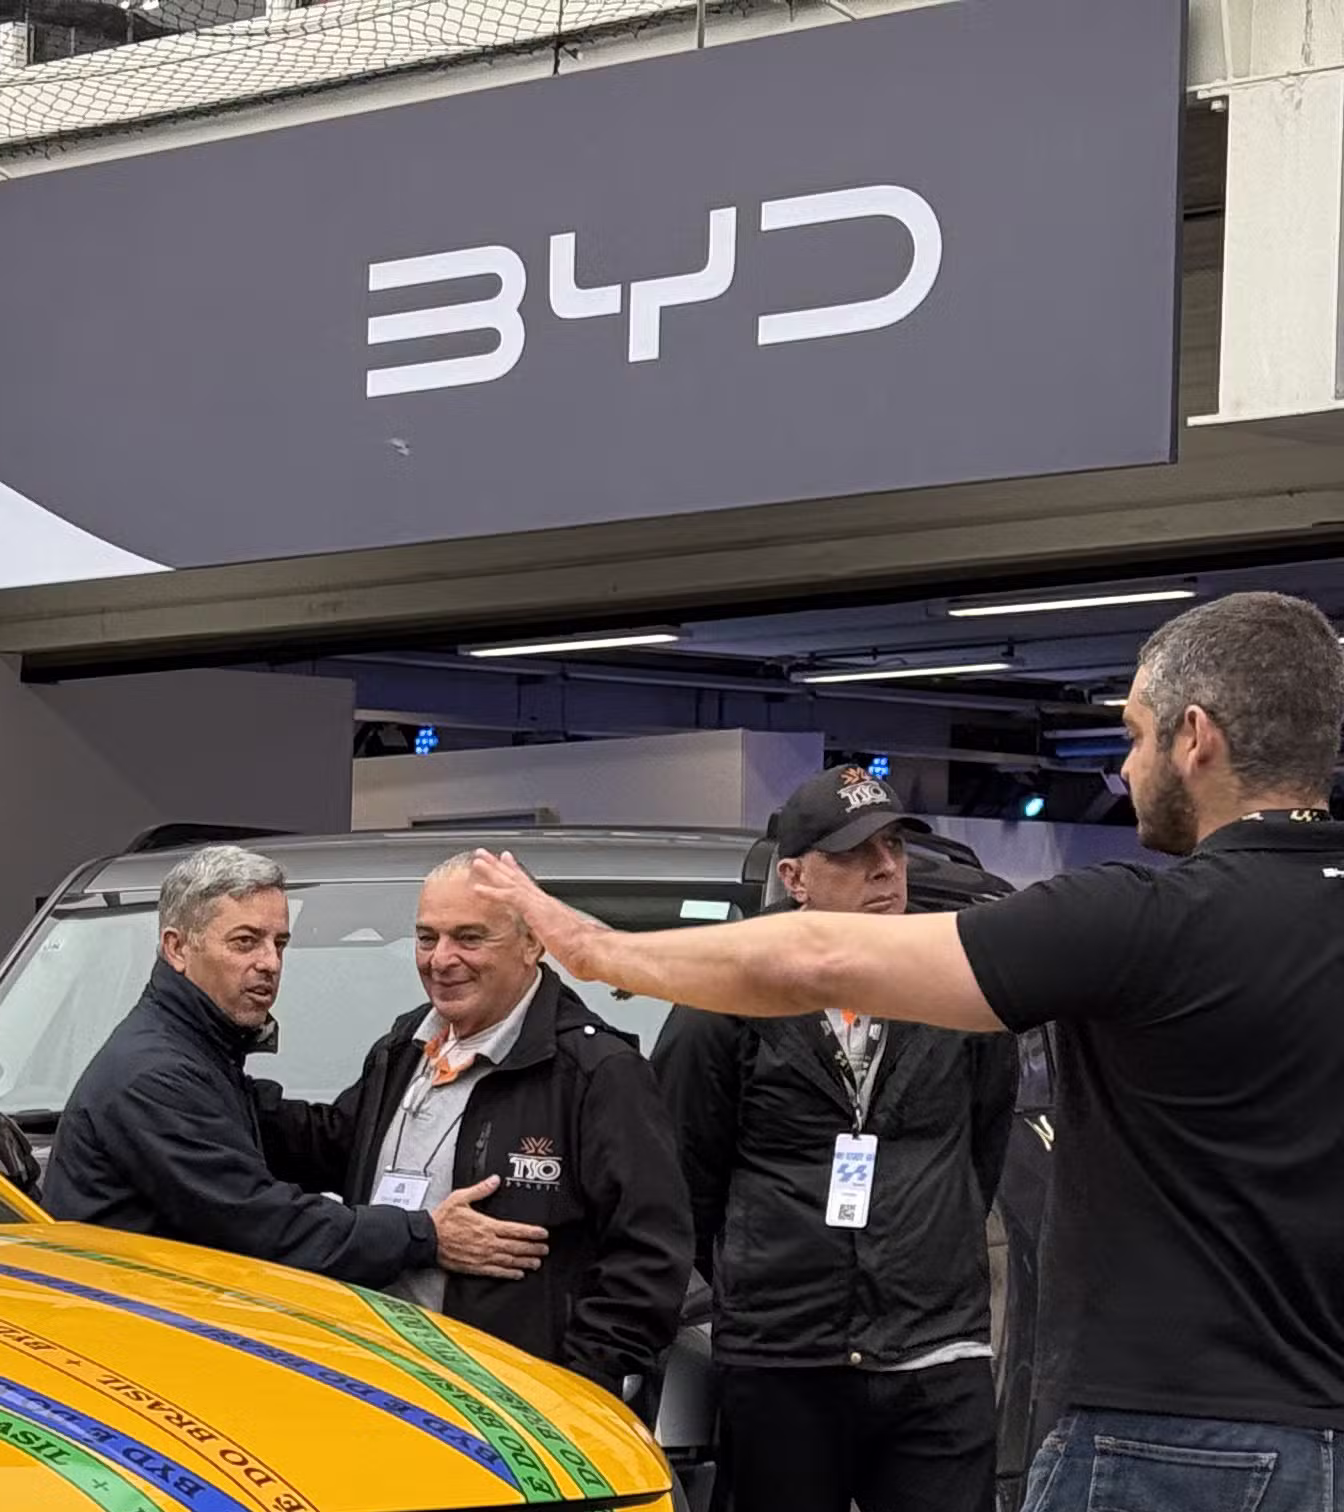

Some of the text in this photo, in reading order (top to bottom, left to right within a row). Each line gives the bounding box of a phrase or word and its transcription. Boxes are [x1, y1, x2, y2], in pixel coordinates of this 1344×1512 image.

[367, 184, 943, 399] BYD
[97, 1374, 217, 1442] BRASIL
[420, 1417, 502, 1465] BYD
[498, 1433, 541, 1472] DO
[121, 1447, 204, 1499] BYD
[218, 1448, 276, 1487] DO
[559, 1447, 606, 1488] DO
